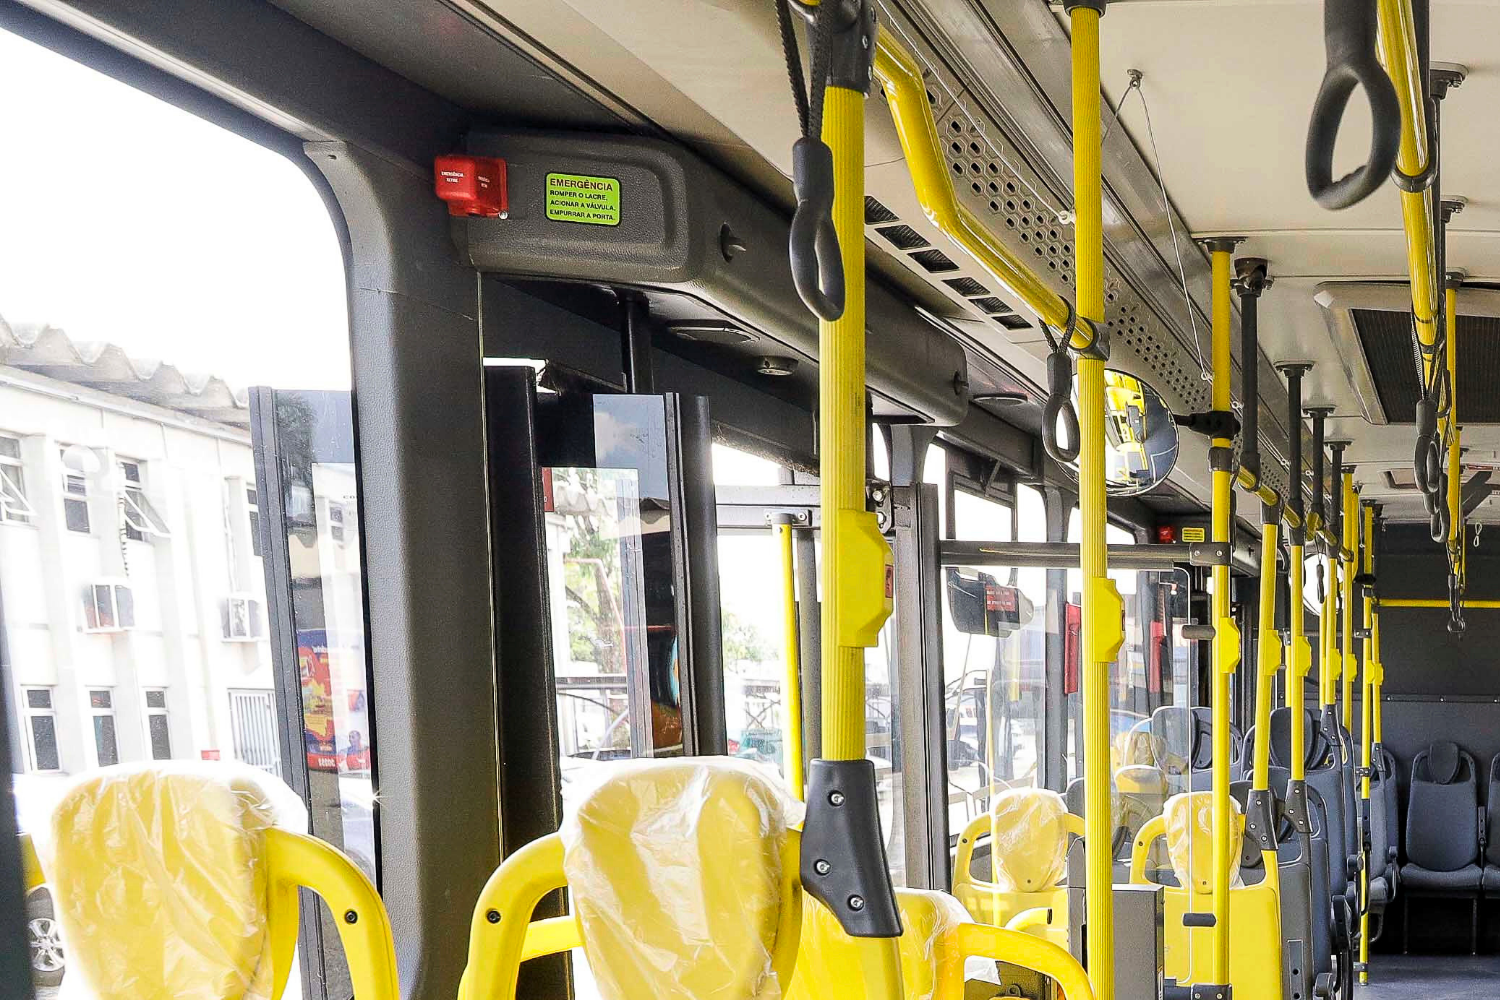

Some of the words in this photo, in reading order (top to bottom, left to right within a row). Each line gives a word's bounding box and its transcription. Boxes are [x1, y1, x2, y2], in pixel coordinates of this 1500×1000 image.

[550, 179, 612, 191] EMERGÊNCIA
[550, 190, 577, 198] ROMPER
[550, 209, 585, 218] EMPURRAR
